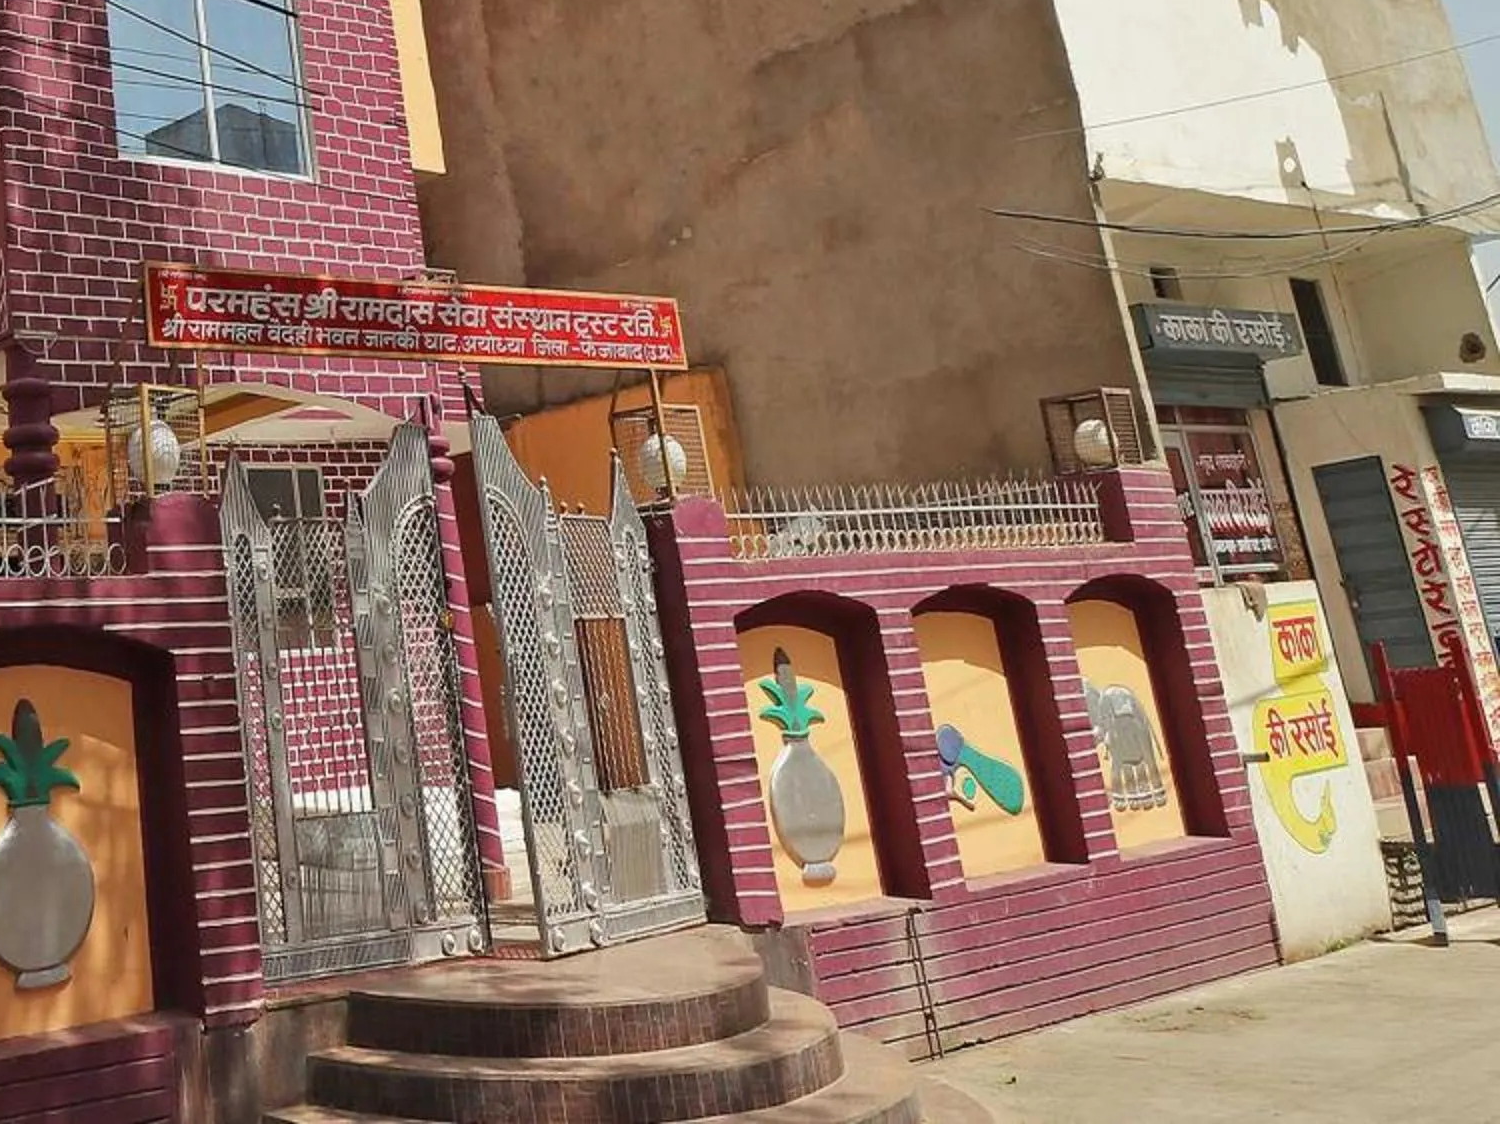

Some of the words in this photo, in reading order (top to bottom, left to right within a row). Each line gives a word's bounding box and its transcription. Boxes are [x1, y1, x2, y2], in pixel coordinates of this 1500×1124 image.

[185, 284, 301, 320] परमहंस
[438, 297, 486, 327] सेवा
[491, 299, 571, 332] संस्थान
[572, 312, 618, 342] ट्रस्ट
[1159, 314, 1209, 343] काका
[1207, 309, 1234, 345] की
[1233, 312, 1288, 353] रसोई
[316, 326, 359, 346] भवन
[363, 324, 422, 350] जानकी
[531, 332, 568, 356] जिला
[1272, 615, 1324, 662] काका
[1265, 708, 1291, 758] की
[1288, 698, 1339, 758] रसोई
